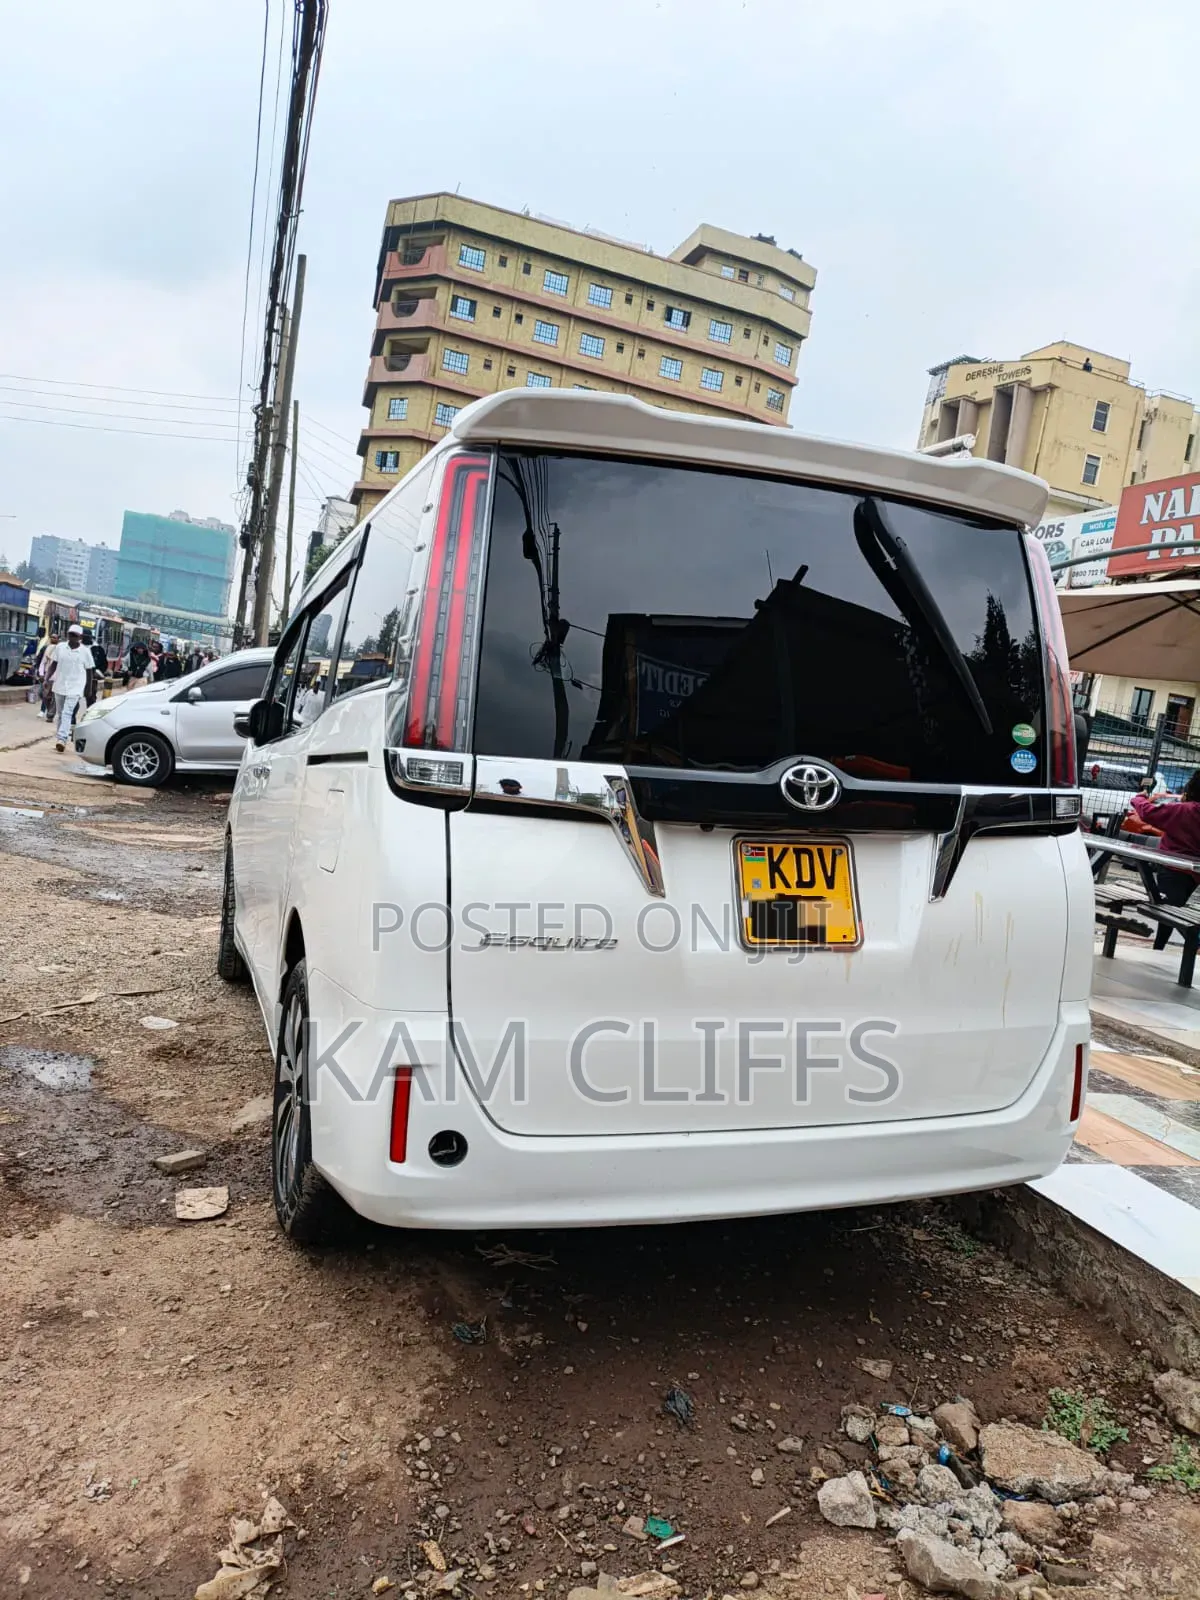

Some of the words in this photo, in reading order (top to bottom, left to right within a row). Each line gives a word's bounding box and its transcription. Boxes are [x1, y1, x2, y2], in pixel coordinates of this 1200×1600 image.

[965, 364, 1004, 382] DERESHE
[997, 365, 1032, 382] TOWERS
[1080, 539, 1095, 548] CAR
[767, 846, 838, 890] KDV
[479, 931, 619, 952] Esquire
